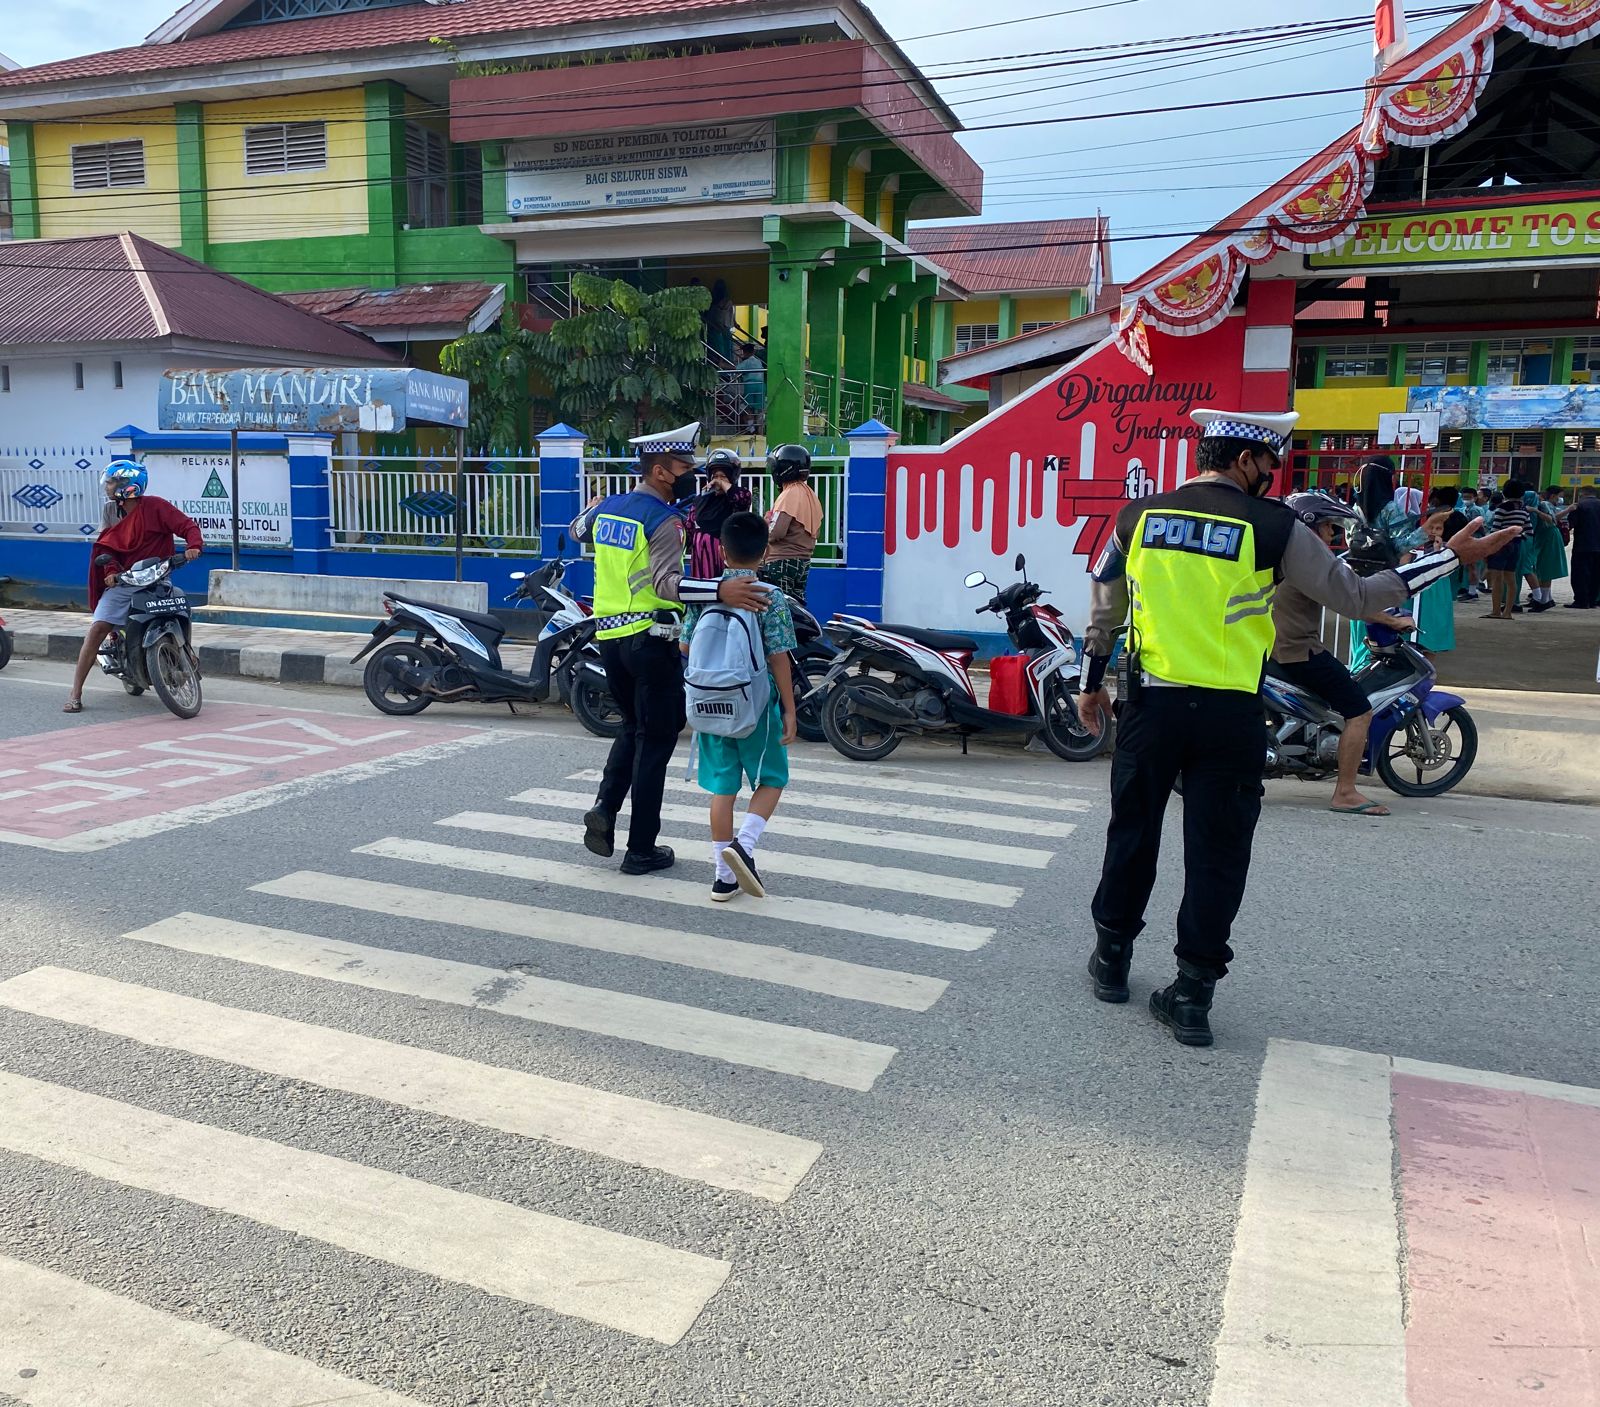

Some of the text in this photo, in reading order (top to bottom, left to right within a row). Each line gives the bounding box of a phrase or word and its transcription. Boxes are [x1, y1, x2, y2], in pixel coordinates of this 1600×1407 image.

[553, 127, 728, 153] SD NEGERI PEMBINA TOLITOLI
[585, 166, 688, 185] BAGI SELURUH SISWA
[1522, 212, 1576, 248] TO
[170, 374, 374, 406] BANK MANDIRI
[408, 379, 430, 399] BANK
[1056, 374, 1217, 421] Dirgahayu
[176, 411, 196, 424] BANK
[182, 457, 246, 466] PELAKSAA
[1043, 456, 1071, 471] KE
[182, 500, 232, 515] KESEHATA
[242, 501, 288, 516] SEKOLAH
[1144, 517, 1240, 556] POLISI
[696, 703, 734, 715] PUMA
